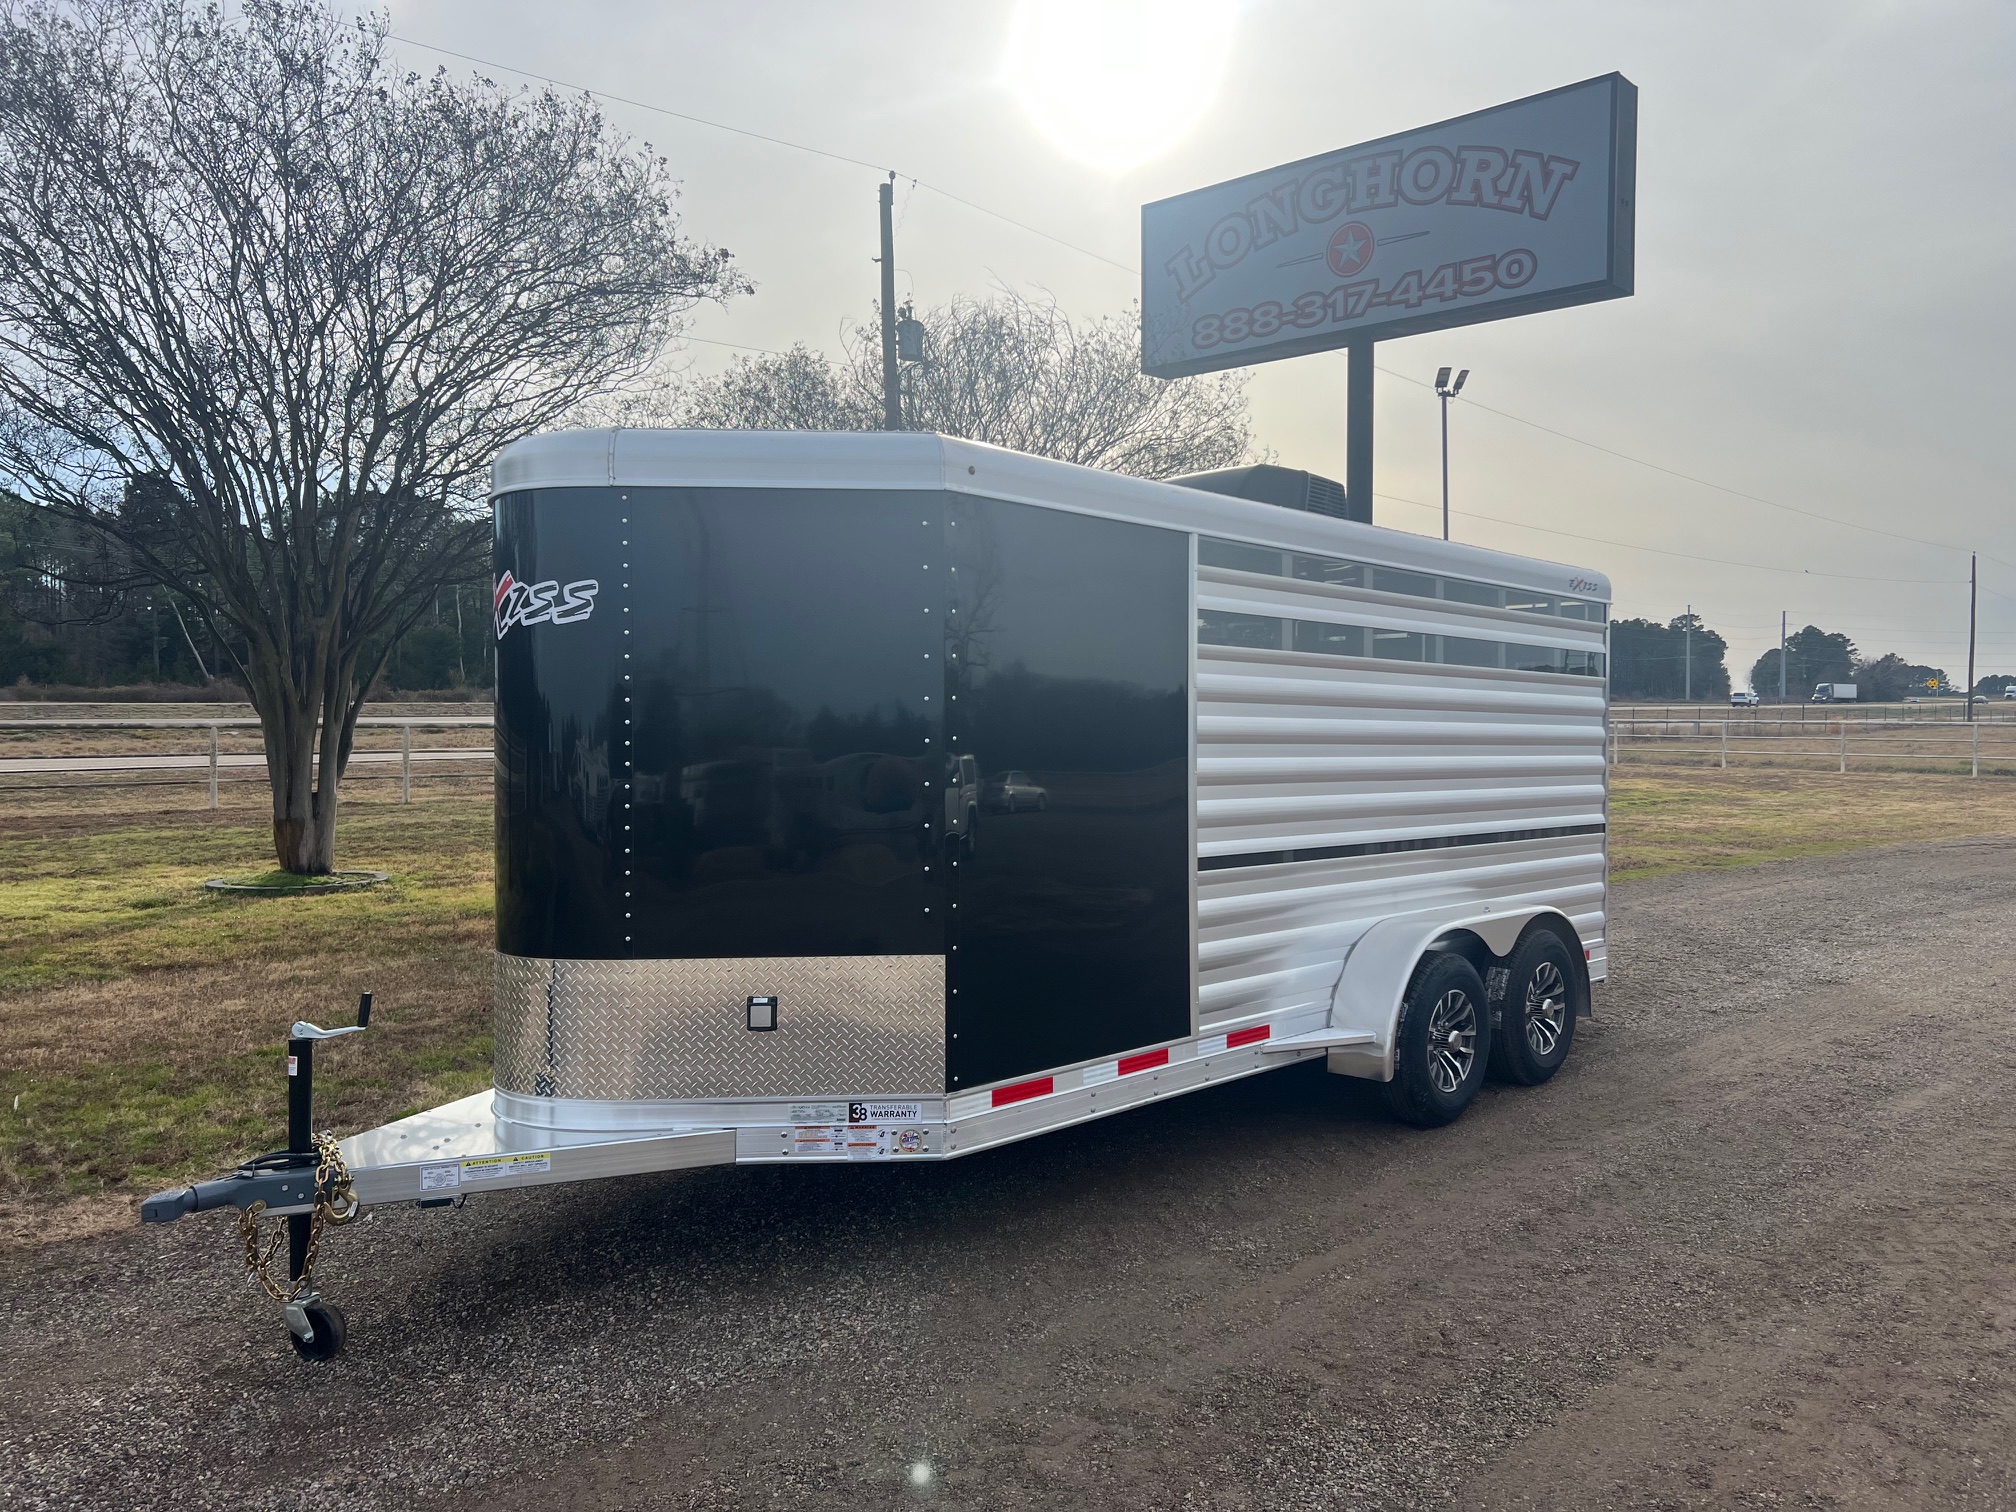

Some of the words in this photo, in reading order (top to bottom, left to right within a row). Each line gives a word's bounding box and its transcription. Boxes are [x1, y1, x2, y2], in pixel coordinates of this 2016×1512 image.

[1164, 145, 1581, 304] LONGHORN
[1191, 248, 1538, 349] 888-317-4450
[870, 1110, 918, 1118] WARRANTY
